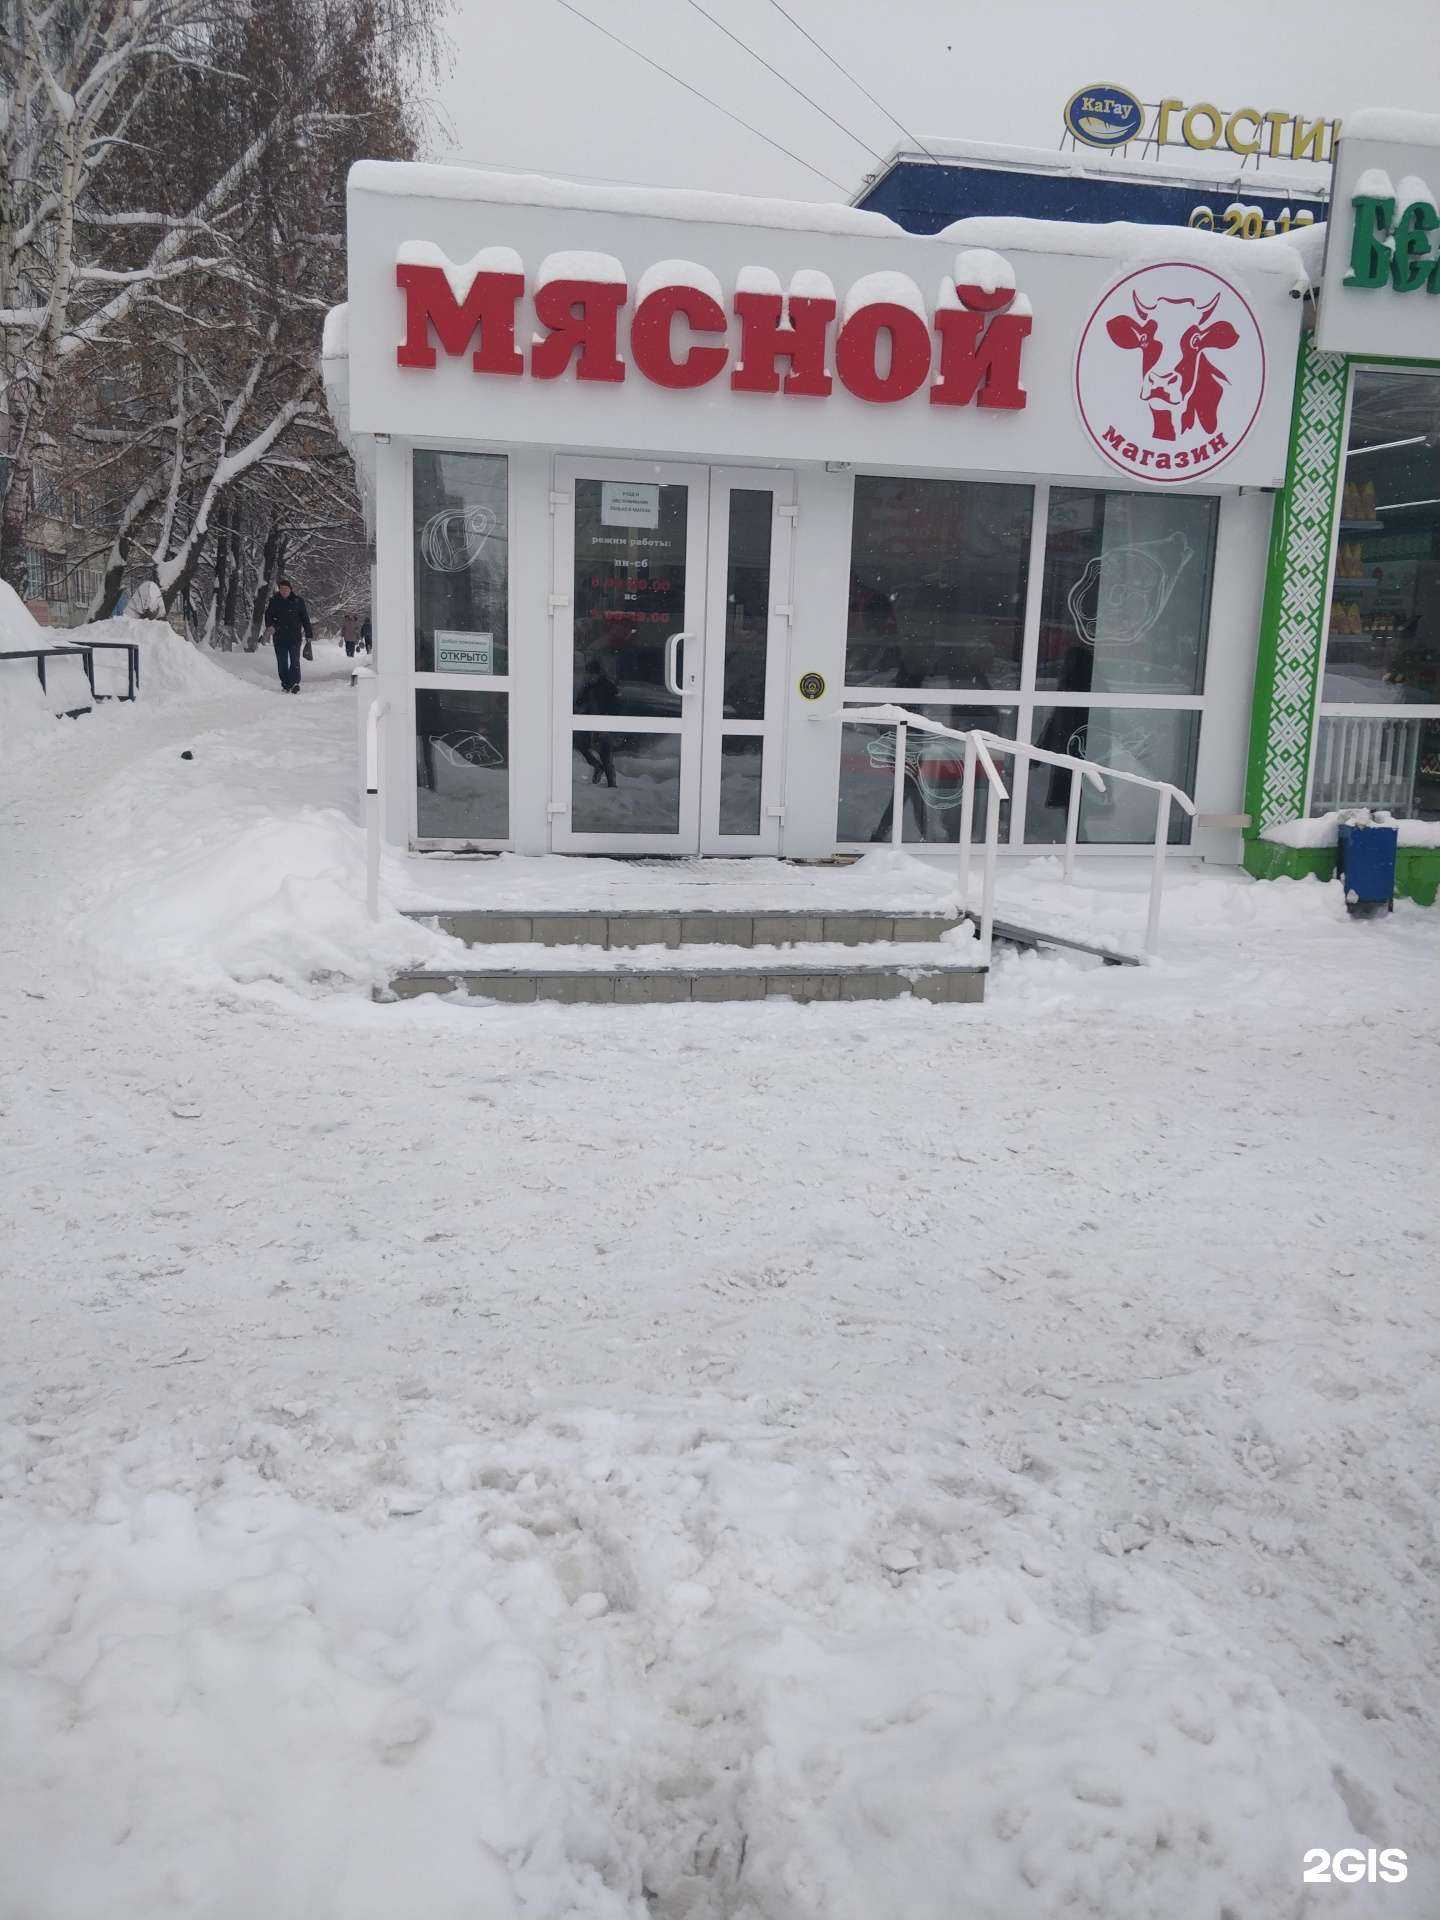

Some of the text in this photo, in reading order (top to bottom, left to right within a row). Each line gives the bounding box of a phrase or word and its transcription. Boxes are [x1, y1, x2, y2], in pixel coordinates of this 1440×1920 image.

[1343, 195, 1440, 294] БЕ
[396, 263, 1033, 410] МЯСНОЙ
[1102, 425, 1229, 469] магазин
[440, 651, 488, 662] ОТКРЫТО
